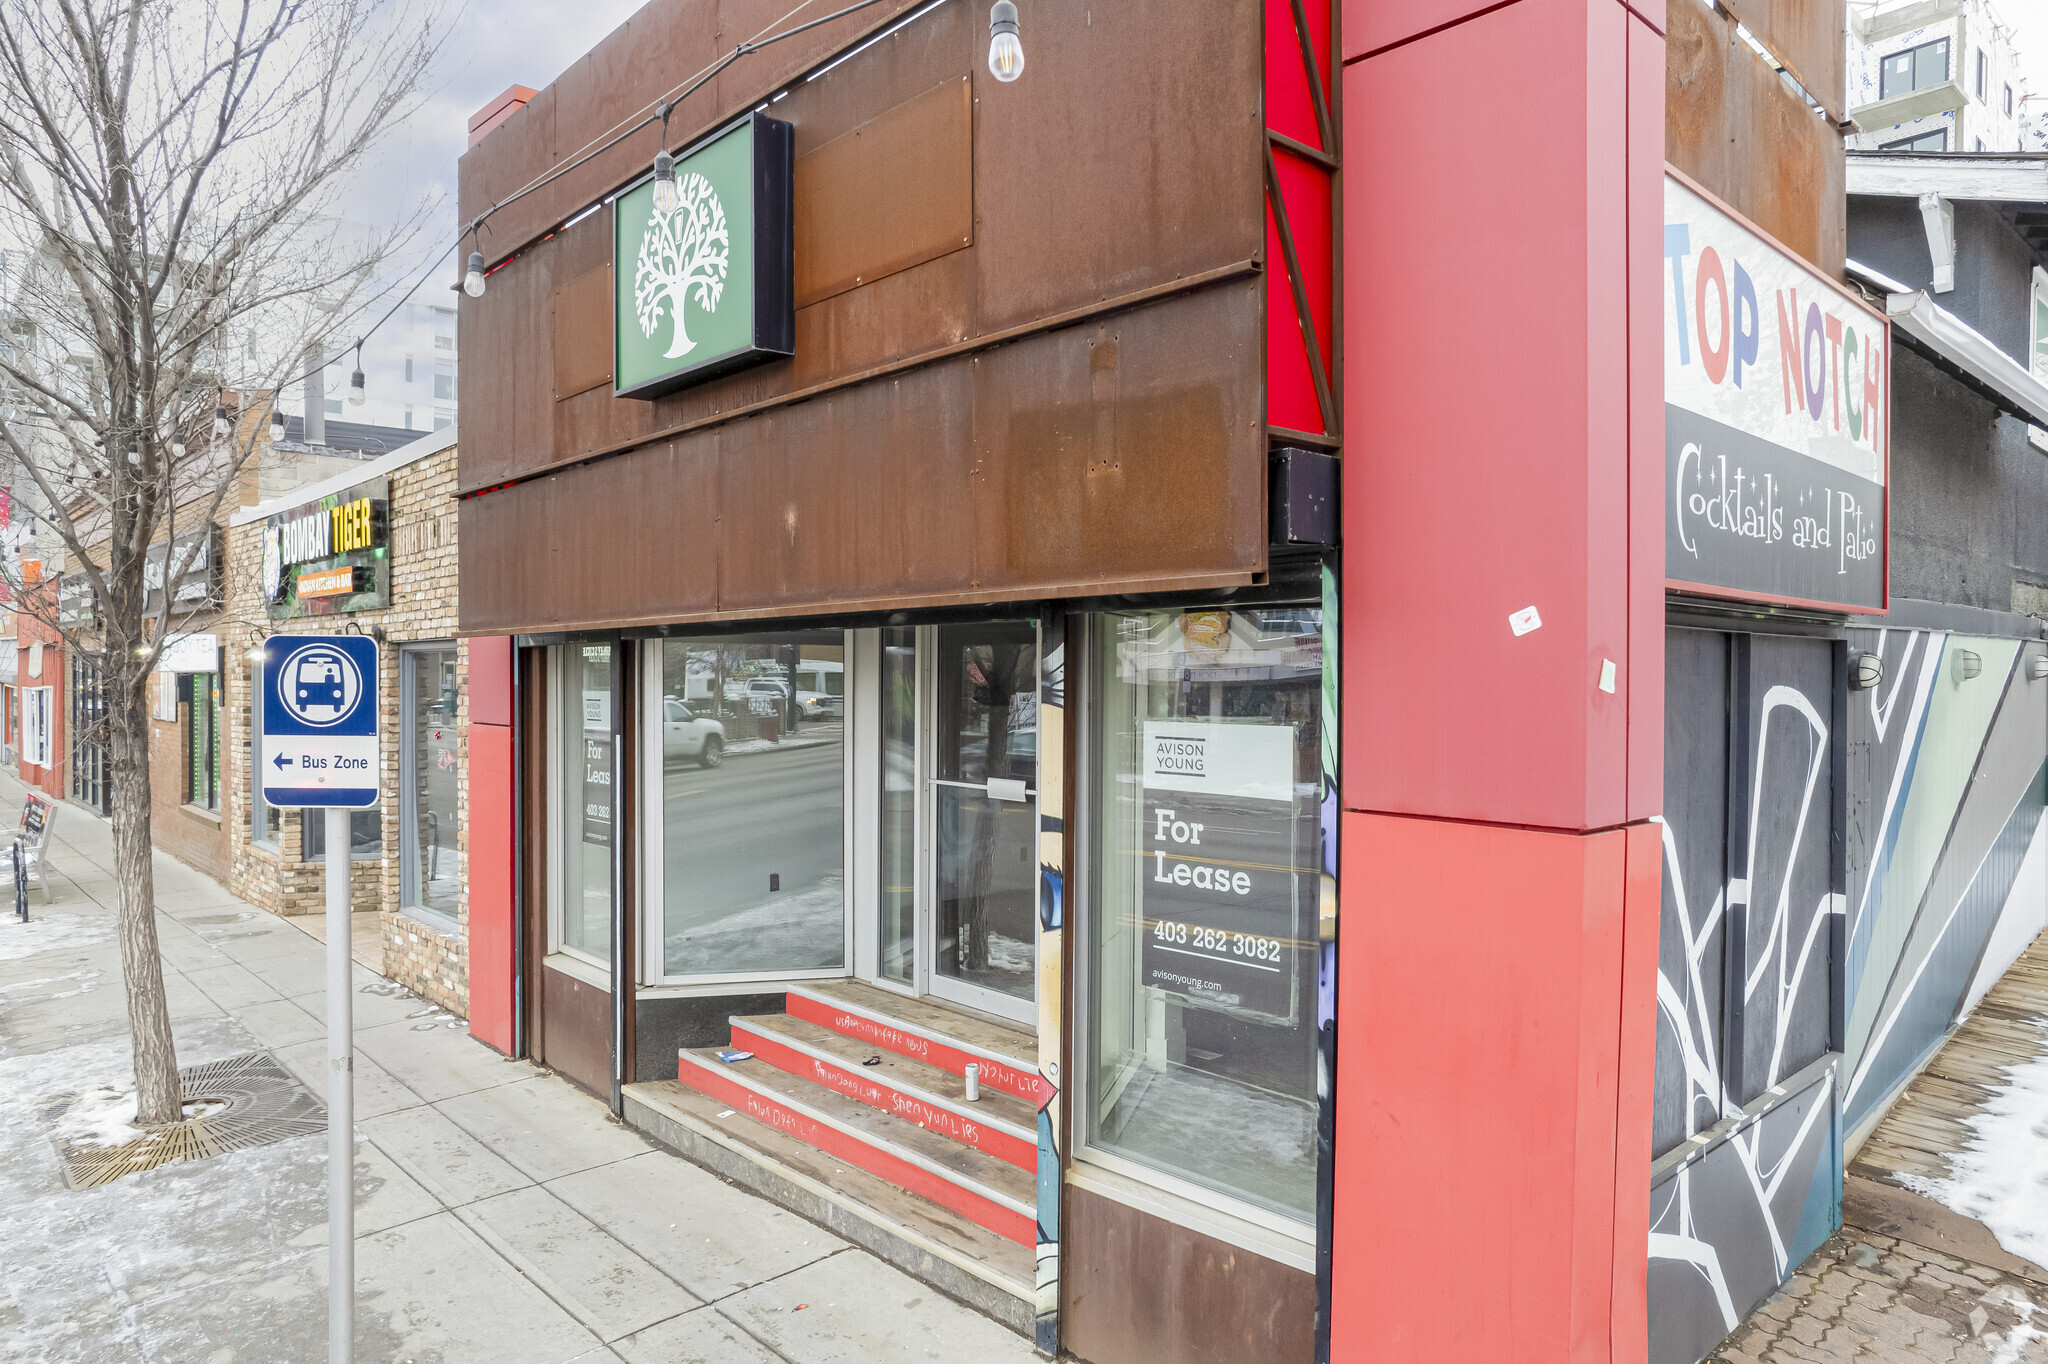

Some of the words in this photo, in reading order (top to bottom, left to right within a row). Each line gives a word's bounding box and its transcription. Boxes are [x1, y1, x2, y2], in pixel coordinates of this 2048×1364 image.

[1664, 223, 1759, 390] TOP
[1776, 287, 1880, 455] NOTCH
[1676, 442, 1783, 560] Cocktails
[1793, 488, 1831, 551] and
[1837, 490, 1876, 575] Patio
[283, 509, 331, 565] BOMBAY
[332, 496, 373, 554] TIGER
[341, 572, 352, 588] BAR
[587, 740, 602, 759] For
[1156, 742, 1204, 757] AVISON
[302, 754, 328, 769] Bus
[333, 754, 368, 769] Zone
[1156, 756, 1204, 771] YOUNG
[586, 803, 597, 816] 403
[598, 805, 610, 818] 262
[1154, 808, 1204, 845] For
[1154, 850, 1251, 895] Lease
[1154, 920, 1187, 944] 403
[1192, 926, 1227, 952] 262
[1233, 933, 1281, 963] 3082
[1152, 969, 1222, 992] avisonyoung.com
